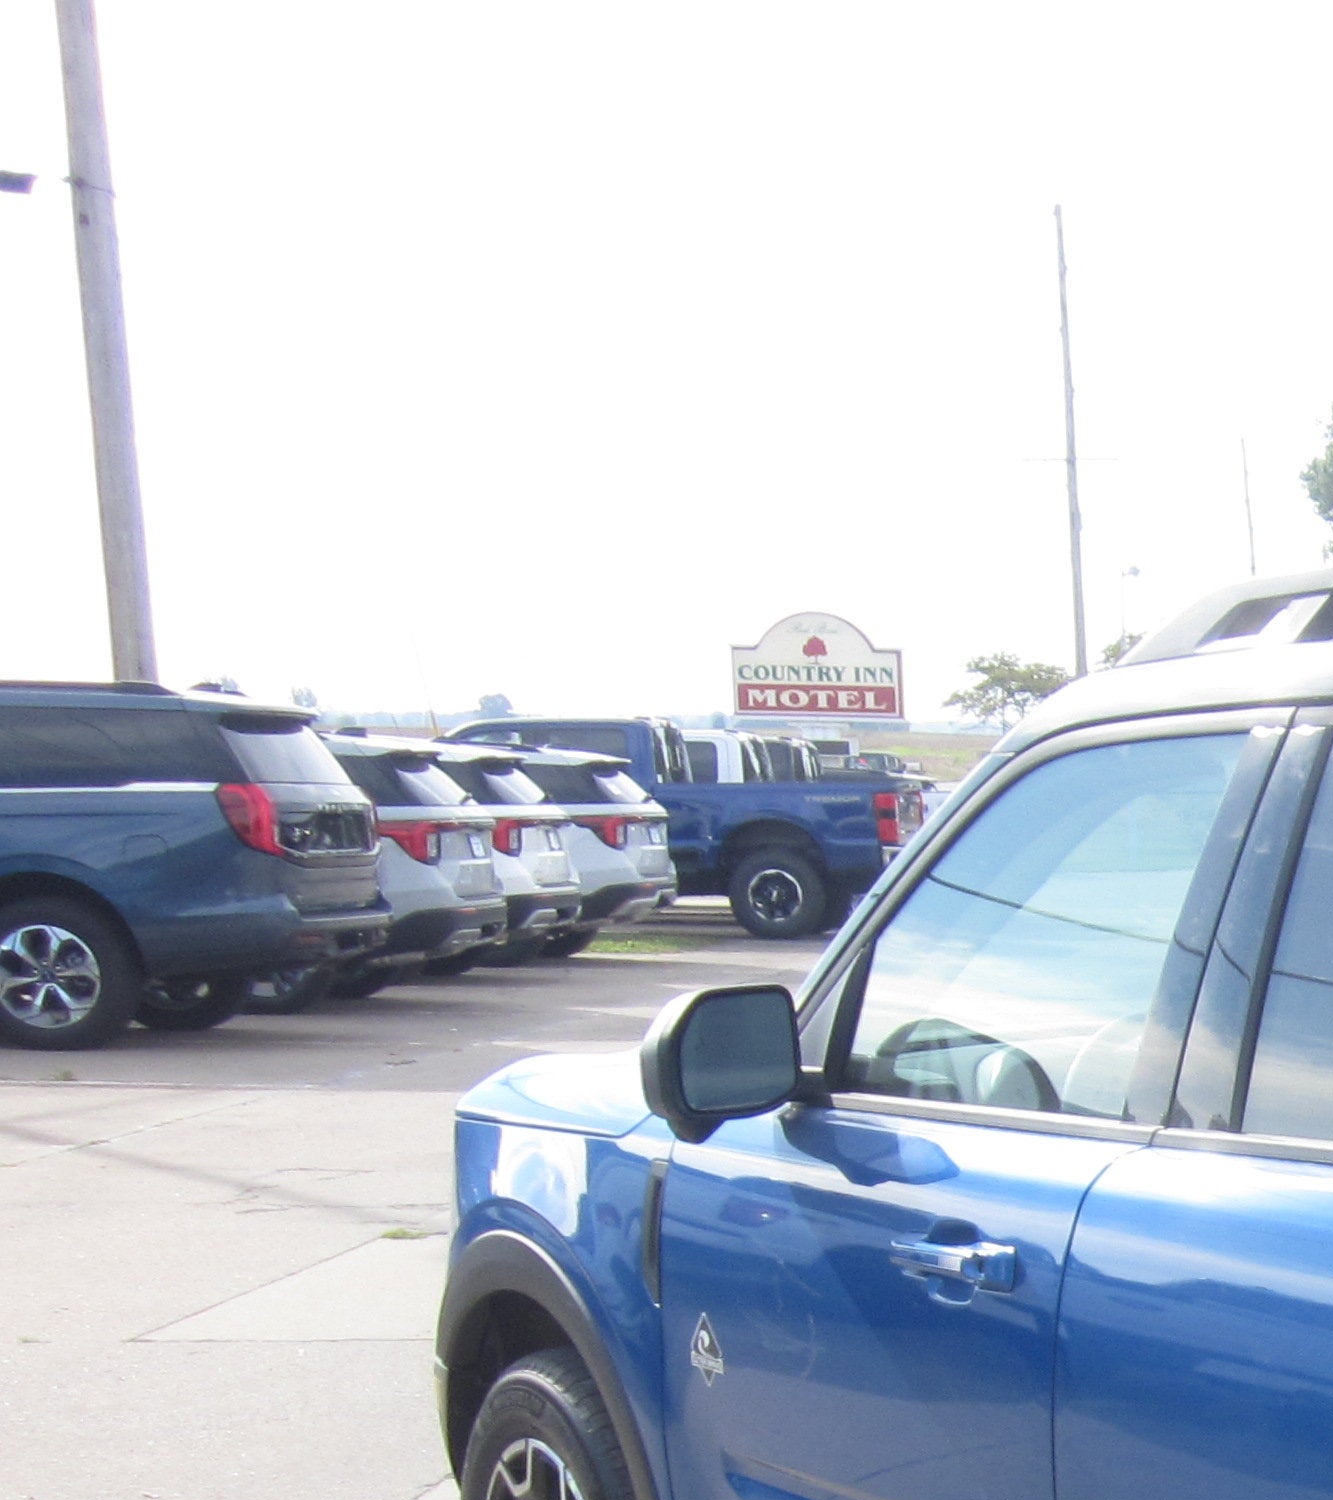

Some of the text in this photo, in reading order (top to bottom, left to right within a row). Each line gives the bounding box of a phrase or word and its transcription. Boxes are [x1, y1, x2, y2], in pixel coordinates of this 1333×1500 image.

[738, 665, 894, 684] COUNTRY INN
[748, 688, 888, 710] MOTEL
